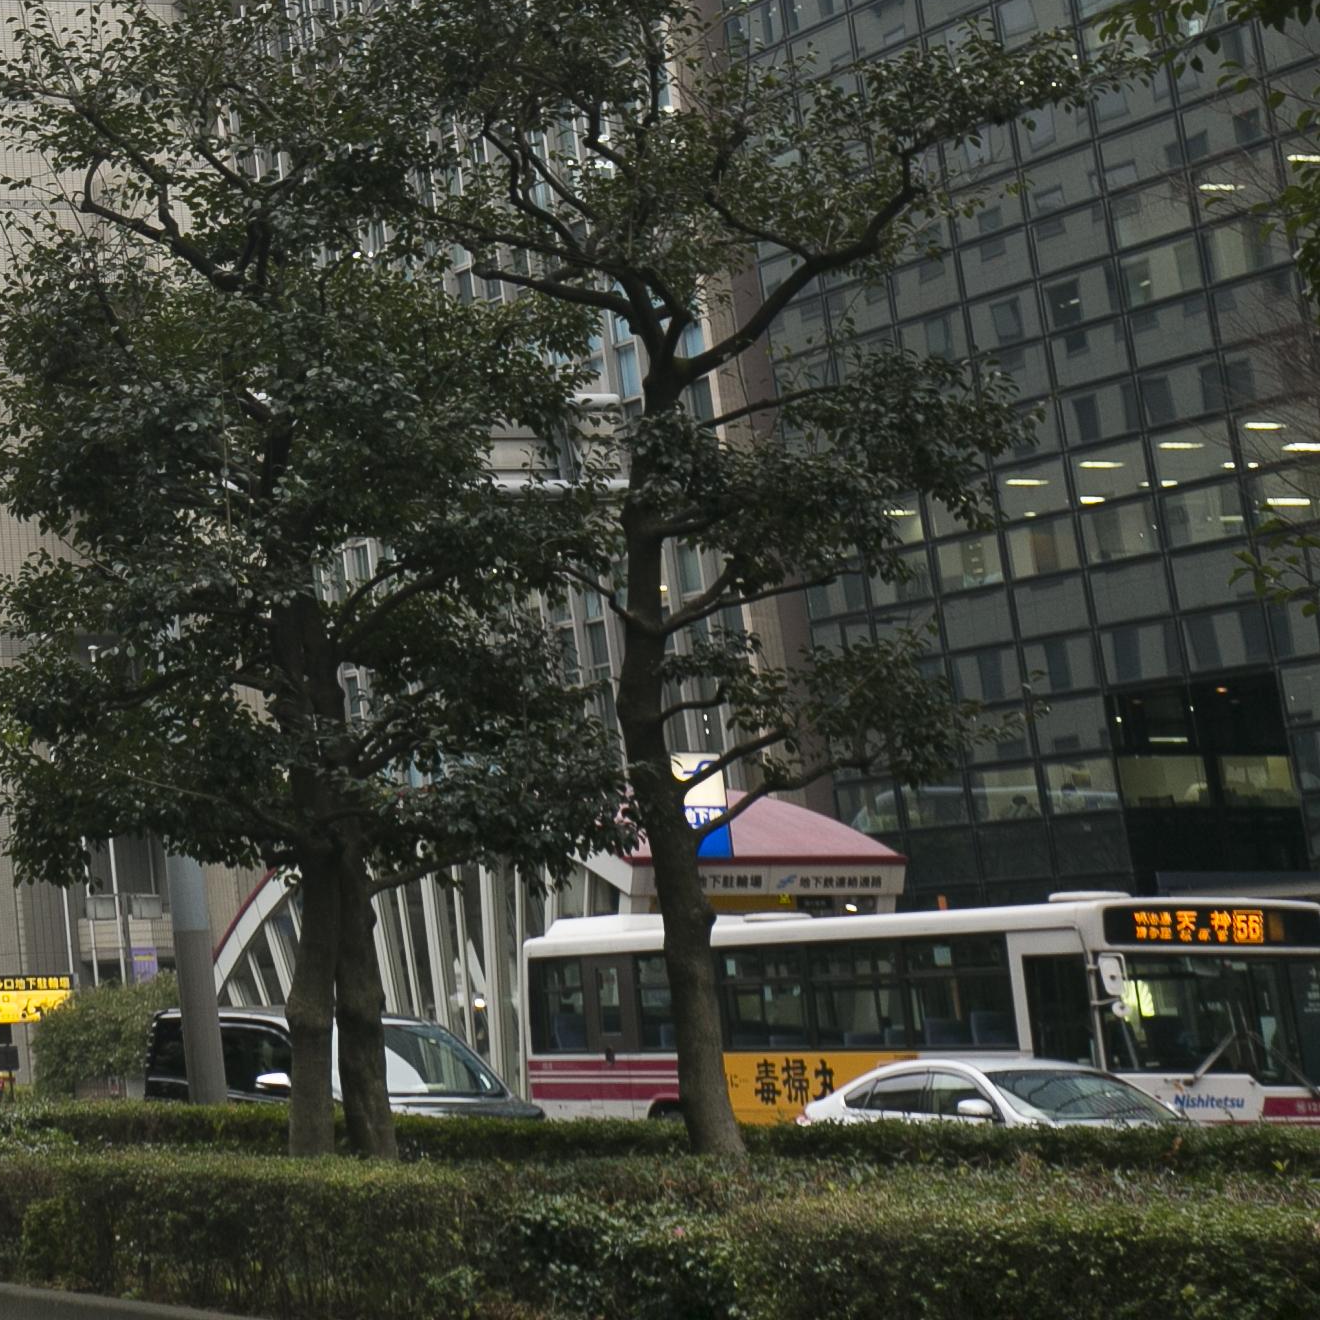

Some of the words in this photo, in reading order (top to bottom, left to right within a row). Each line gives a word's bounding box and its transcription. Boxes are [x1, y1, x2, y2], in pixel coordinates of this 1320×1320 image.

[1236, 914, 1261, 940] 56
[754, 1057, 835, 1105] 毒掃丸
[1174, 1094, 1246, 1108] Nishitetsu
